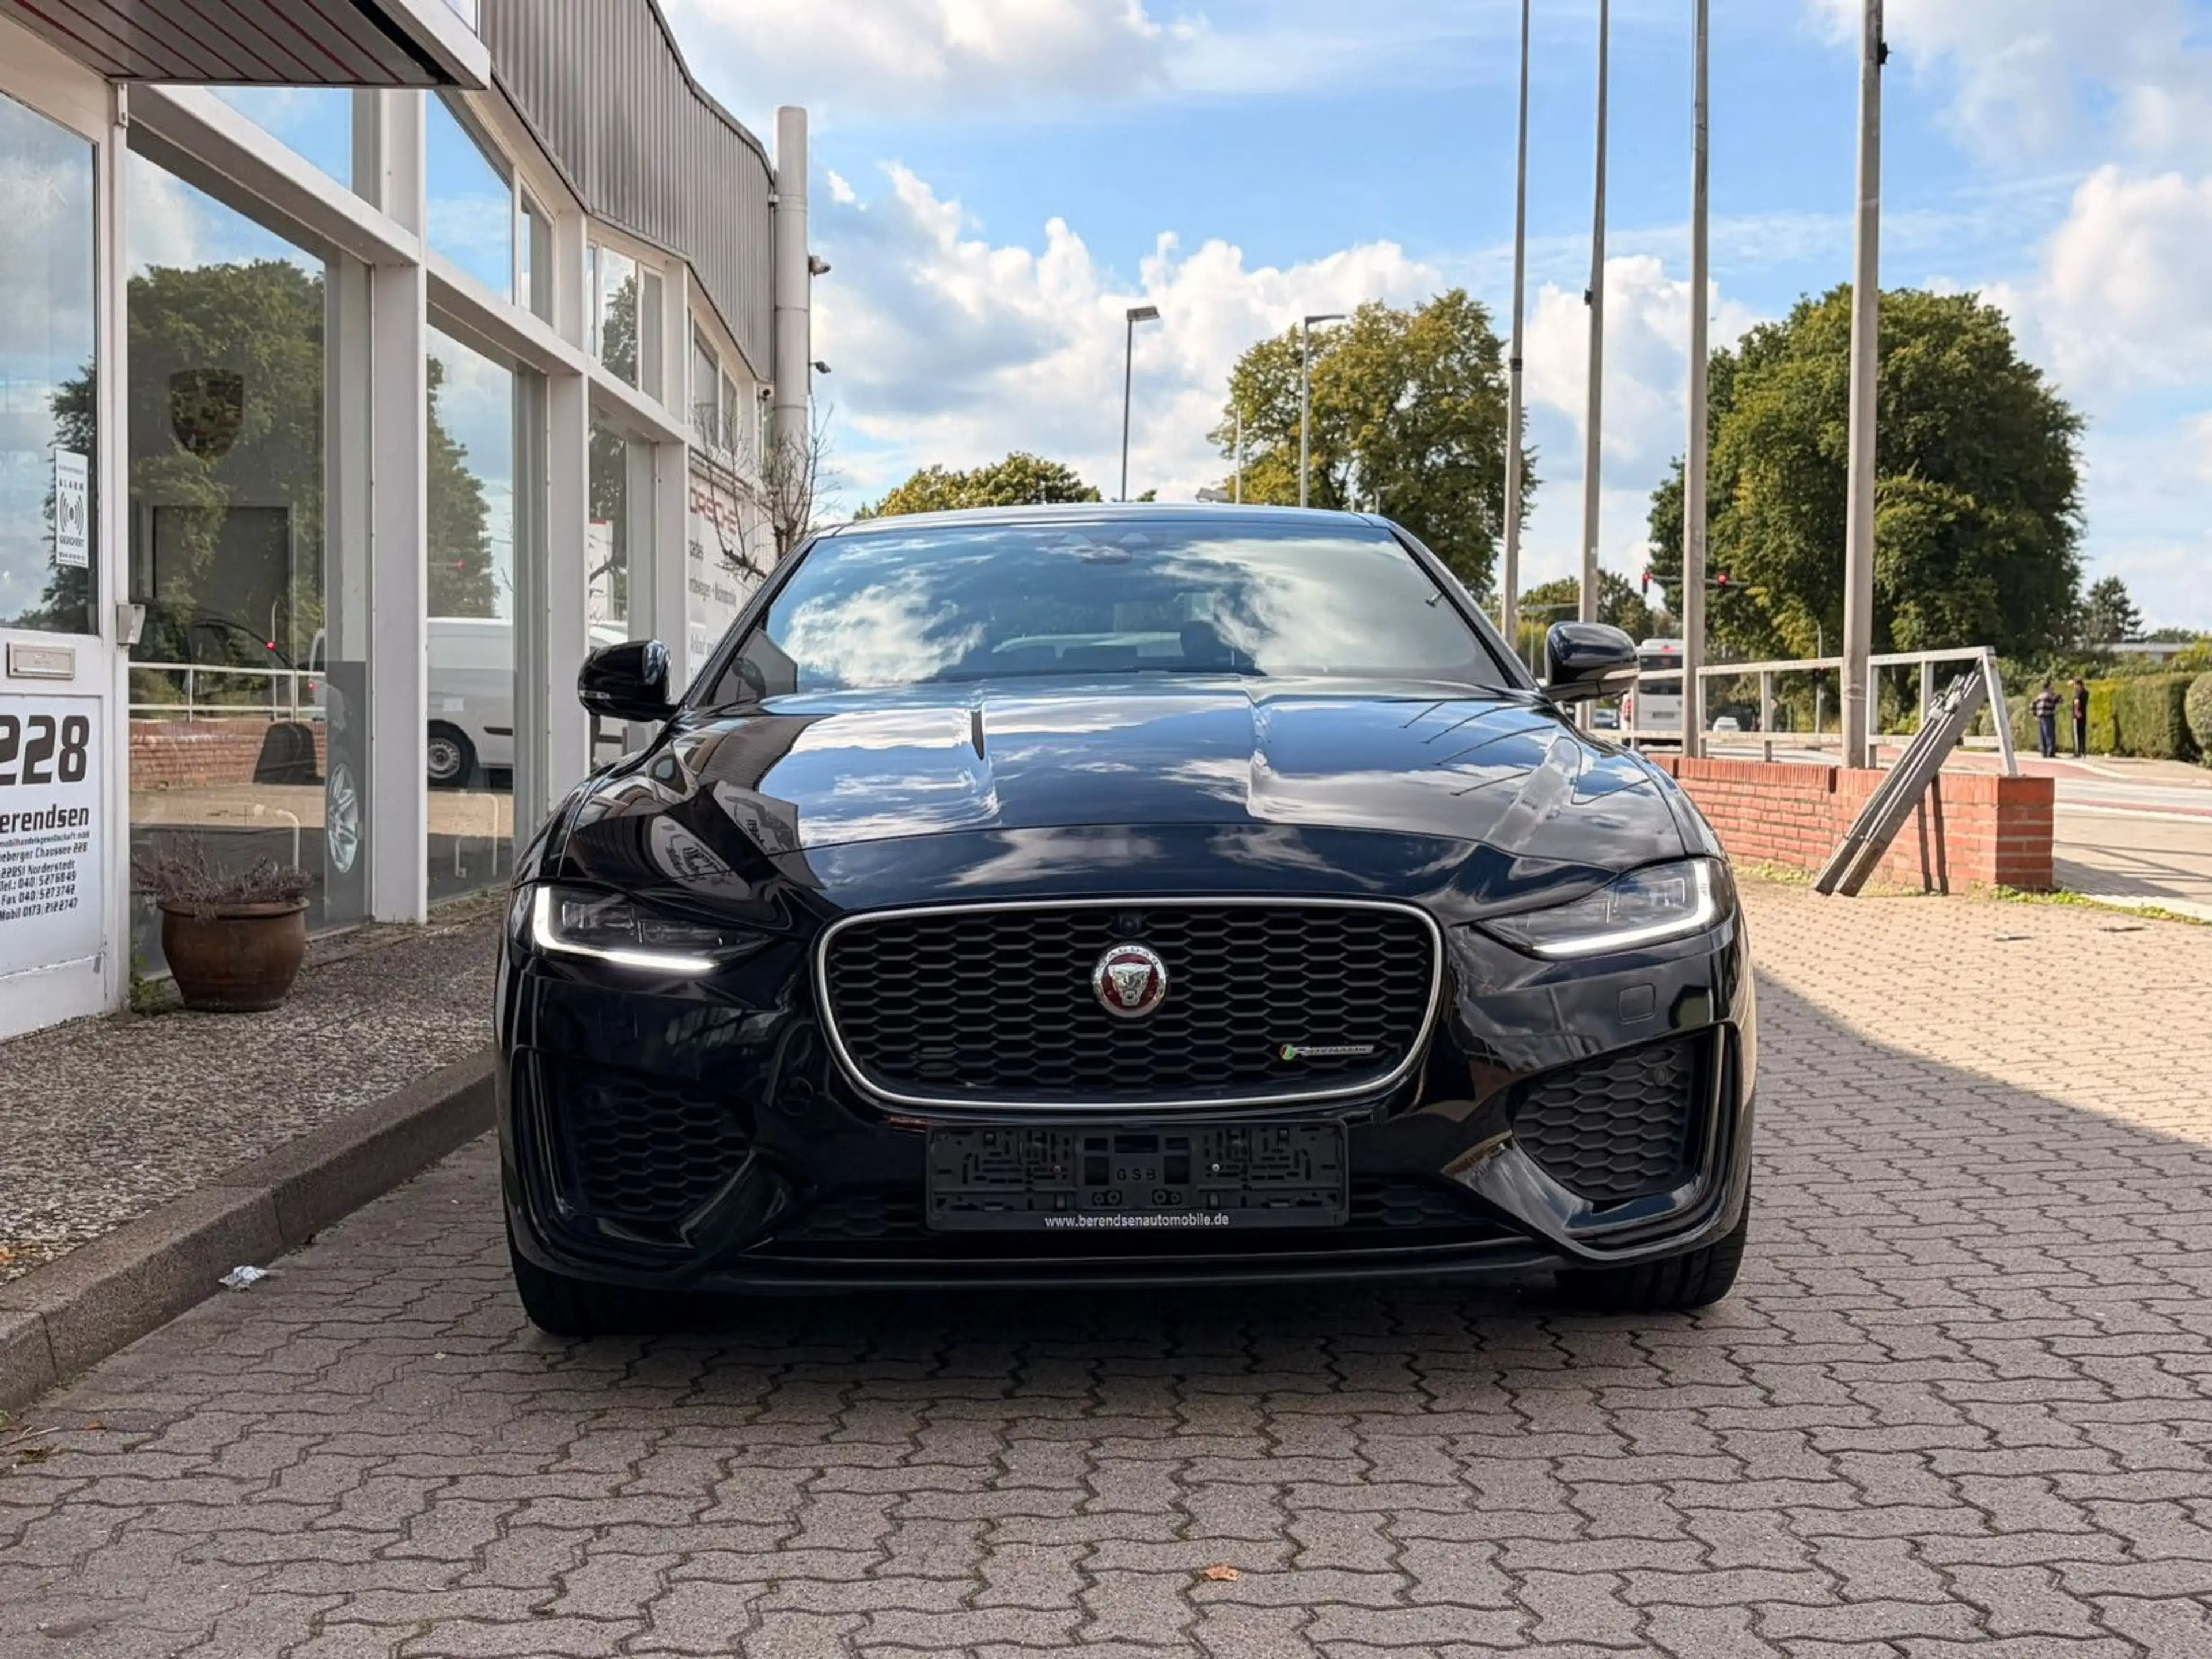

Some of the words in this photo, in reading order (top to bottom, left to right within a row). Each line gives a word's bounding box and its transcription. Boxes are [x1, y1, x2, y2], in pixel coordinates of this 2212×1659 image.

[0, 715, 89, 785] 228
[0, 804, 89, 833] erendsen
[35, 846, 71, 859] Chaussee
[73, 842, 88, 853] 228
[28, 859, 75, 875] Norderstedt
[1, 894, 16, 906] Fax
[1044, 1213, 1229, 1228] www.berendsenautomobile.de
